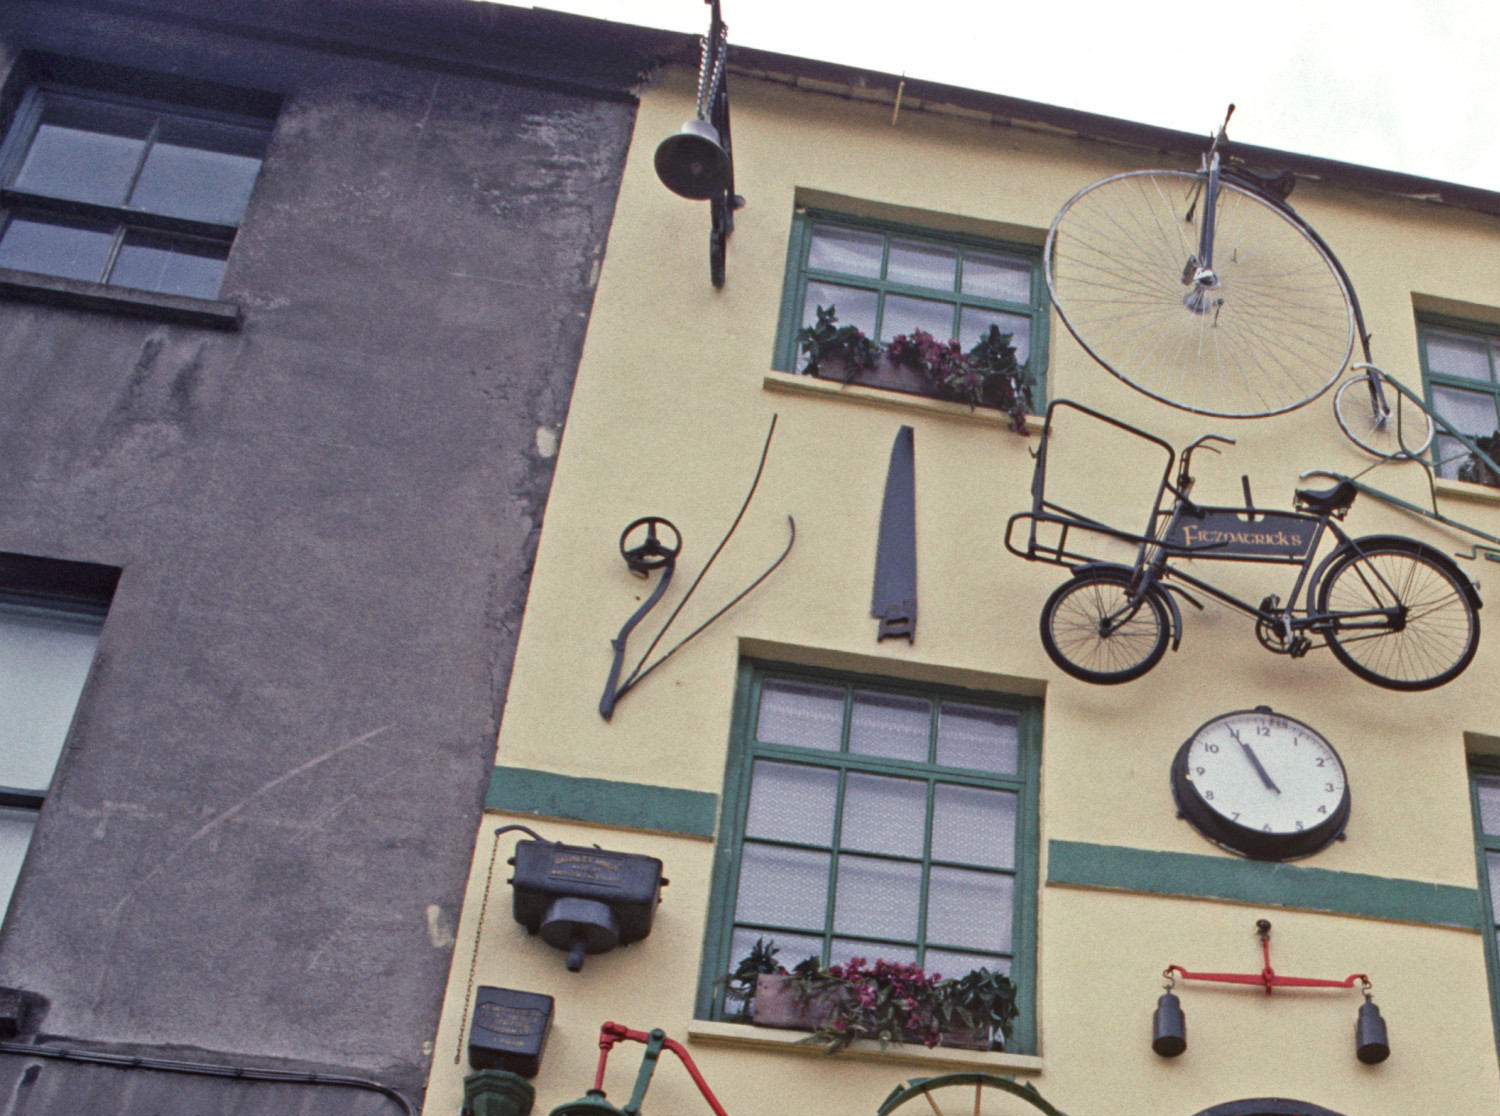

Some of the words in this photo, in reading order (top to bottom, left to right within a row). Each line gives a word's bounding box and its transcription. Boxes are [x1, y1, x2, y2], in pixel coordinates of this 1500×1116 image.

[1257, 726, 1271, 737] 12
[1204, 743, 1220, 754] 10
[1315, 758, 1325, 767] 2
[1196, 767, 1206, 776] 9
[1325, 783, 1335, 793] 3
[1205, 790, 1214, 800] 8
[1317, 805, 1327, 815] 4
[1231, 812, 1240, 822] 7
[1263, 824, 1272, 833] 6
[1295, 821, 1304, 832] 5
